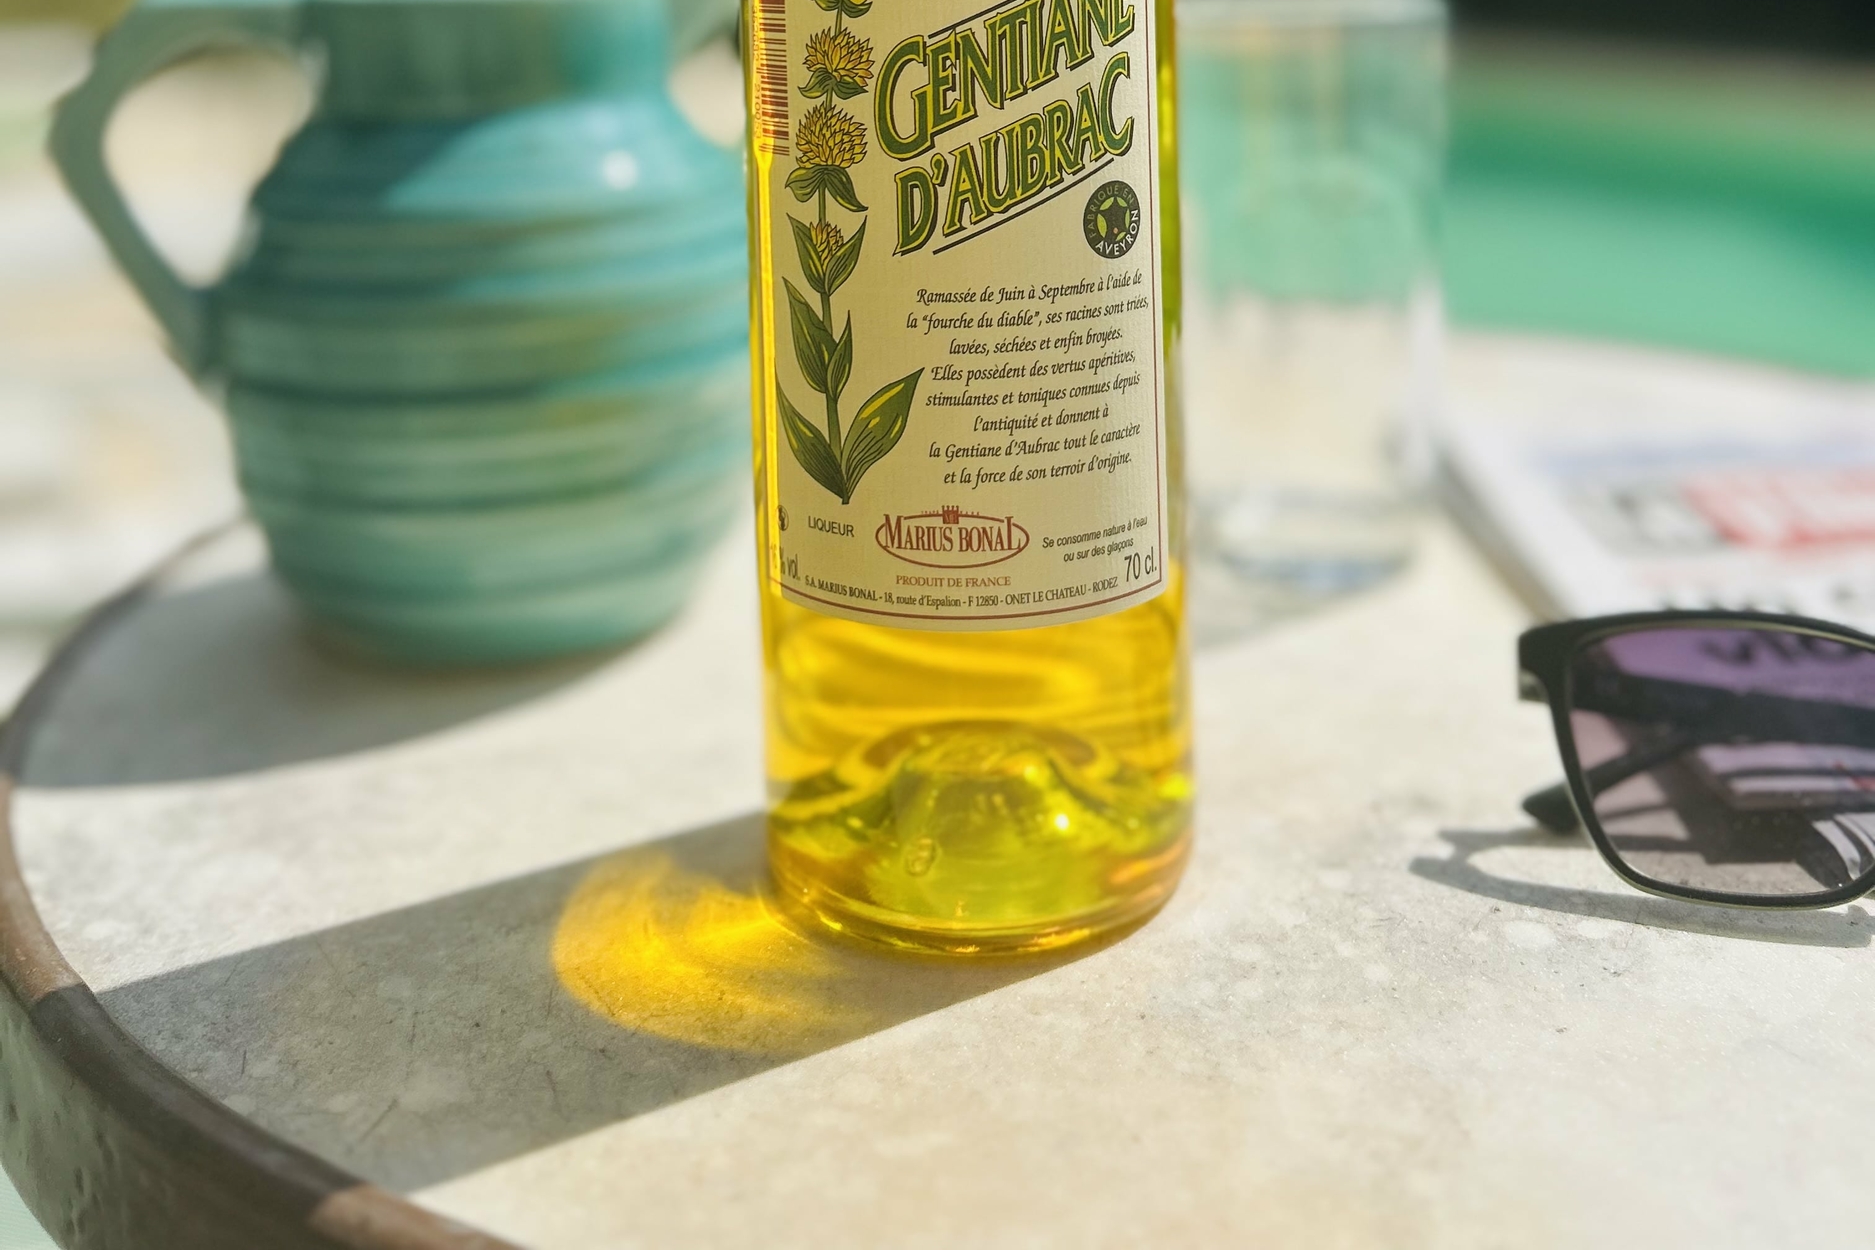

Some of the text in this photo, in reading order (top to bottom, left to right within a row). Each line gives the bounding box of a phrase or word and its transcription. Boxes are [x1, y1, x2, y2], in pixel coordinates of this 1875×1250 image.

[892, 51, 1134, 256] D’AUBRAC
[1095, 209, 1139, 255] AVEYRON
[916, 288, 976, 306] Ramassée
[979, 286, 994, 303] de
[996, 286, 1025, 304] Juin
[1028, 286, 1036, 300] à
[1038, 278, 1095, 304] Septembre
[1097, 277, 1104, 292] à
[1132, 268, 1143, 285] de
[906, 312, 918, 329] la
[977, 312, 994, 328] du
[1045, 311, 1063, 325] ses
[1065, 305, 1102, 322] racines
[1103, 301, 1125, 317] sont
[949, 326, 1123, 356] lavées, séchées et enfin broyées.
[931, 365, 963, 381] Elles
[965, 363, 1026, 387] possèdent
[1030, 360, 1048, 377] des
[1051, 359, 1086, 375] vertus
[925, 371, 1140, 408] stimulantes et toniques connues depuis
[1041, 413, 1053, 427] et
[1055, 407, 1100, 426] donnent
[1102, 403, 1109, 418] à
[929, 441, 941, 459] la
[944, 443, 1002, 463] Gentiane
[1063, 436, 1086, 451] tout
[1089, 430, 1099, 446] le
[1100, 422, 1140, 444] caractère
[943, 470, 957, 484] et
[959, 467, 972, 484] la
[971, 467, 1006, 490] force
[1009, 465, 1023, 481] de
[1025, 467, 1047, 481] son
[1050, 460, 1086, 479] terroir
[808, 515, 855, 538] LIQUEUR
[883, 514, 1021, 552] MARIUS BONAL
[1042, 537, 1055, 549] Se
[1057, 531, 1101, 547] consomme
[1102, 524, 1125, 539] nature
[1127, 519, 1132, 532] à
[1063, 537, 1134, 563] ou sur des glaçons
[1124, 546, 1157, 583] 70 cl.
[818, 579, 848, 596] MARIUS
[849, 586, 878, 602] BONAL
[896, 595, 917, 606] route
[968, 596, 974, 607] F
[1005, 593, 1032, 606] ONET
[1033, 591, 1044, 603] LE
[1045, 584, 1087, 601] CHATEAU
[1092, 576, 1119, 593] RODEZ
[895, 575, 1011, 588] PRODUIT DE FRANCE
